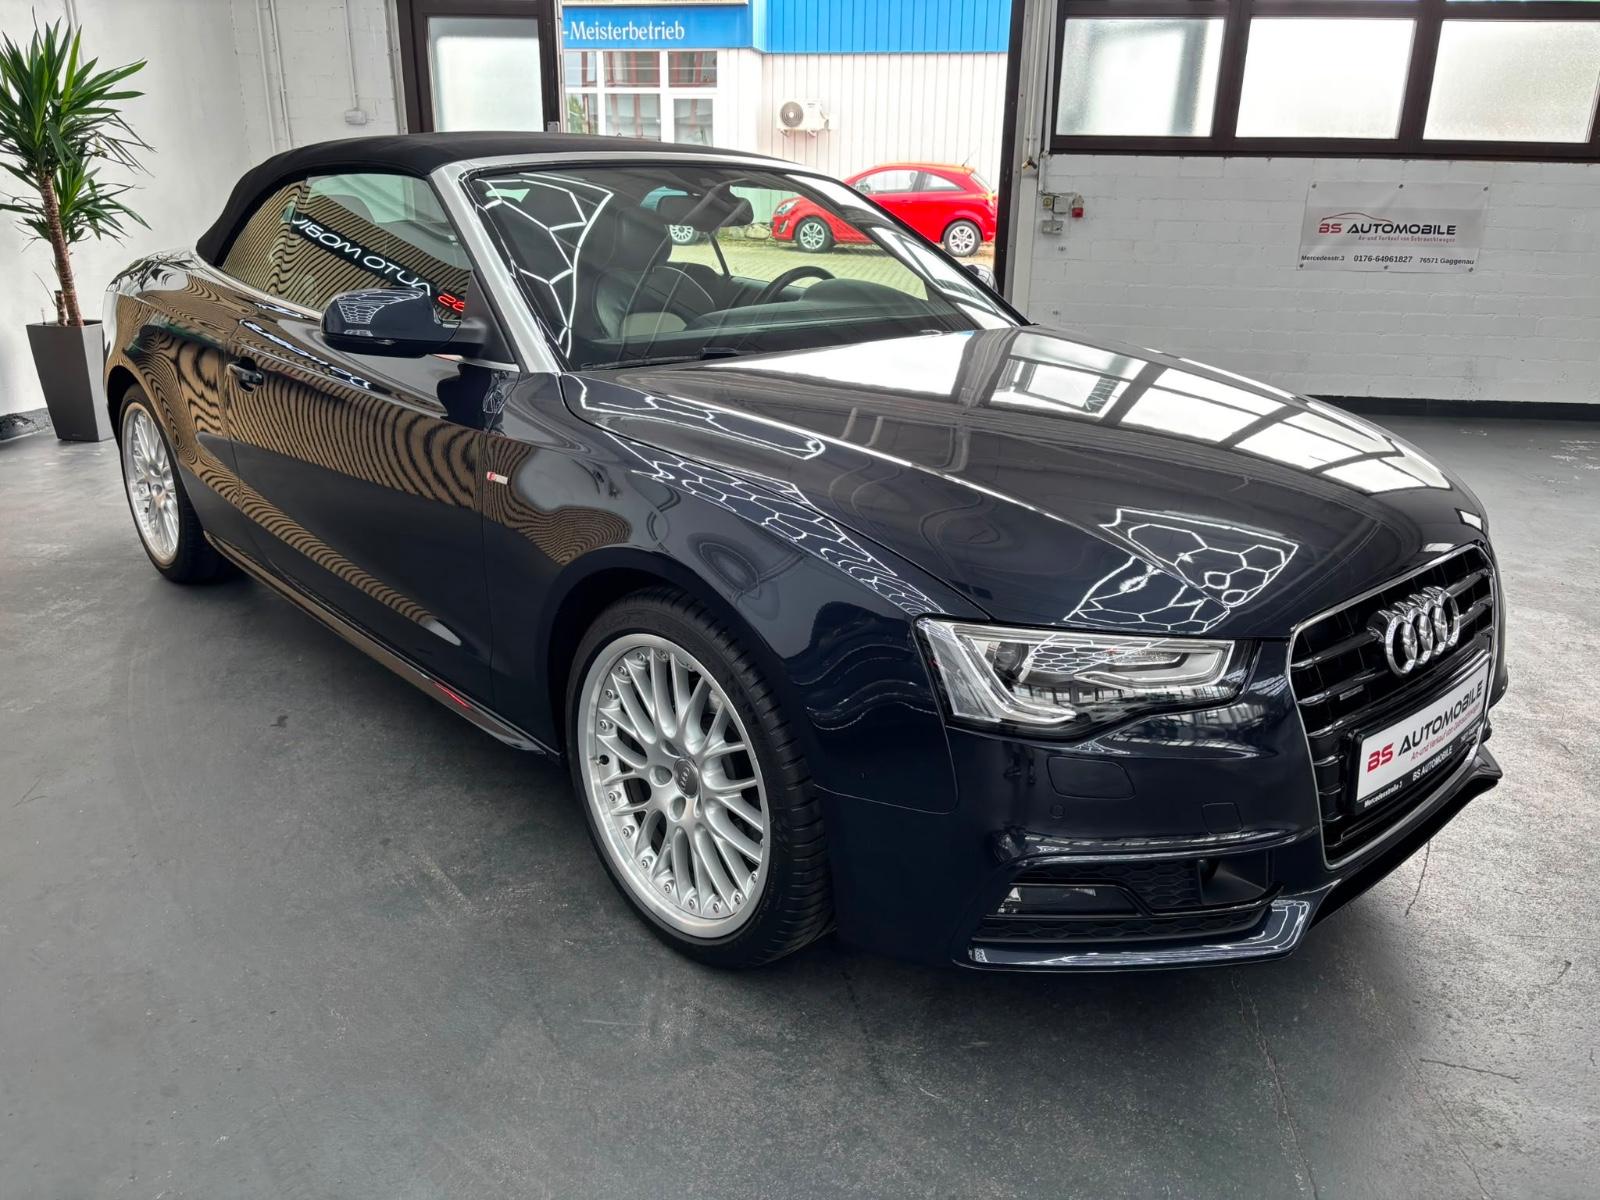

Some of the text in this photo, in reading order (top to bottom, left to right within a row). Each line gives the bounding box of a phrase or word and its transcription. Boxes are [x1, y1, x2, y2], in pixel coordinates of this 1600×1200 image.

[563, 20, 685, 41] -Meisterbetrieb
[1318, 223, 1457, 236] BS AUTOMOBILE
[1353, 255, 1413, 263] 0176-64961827
[1440, 257, 1474, 266] Gaggenau
[1367, 679, 1483, 773] BS AUTOMOBILE
